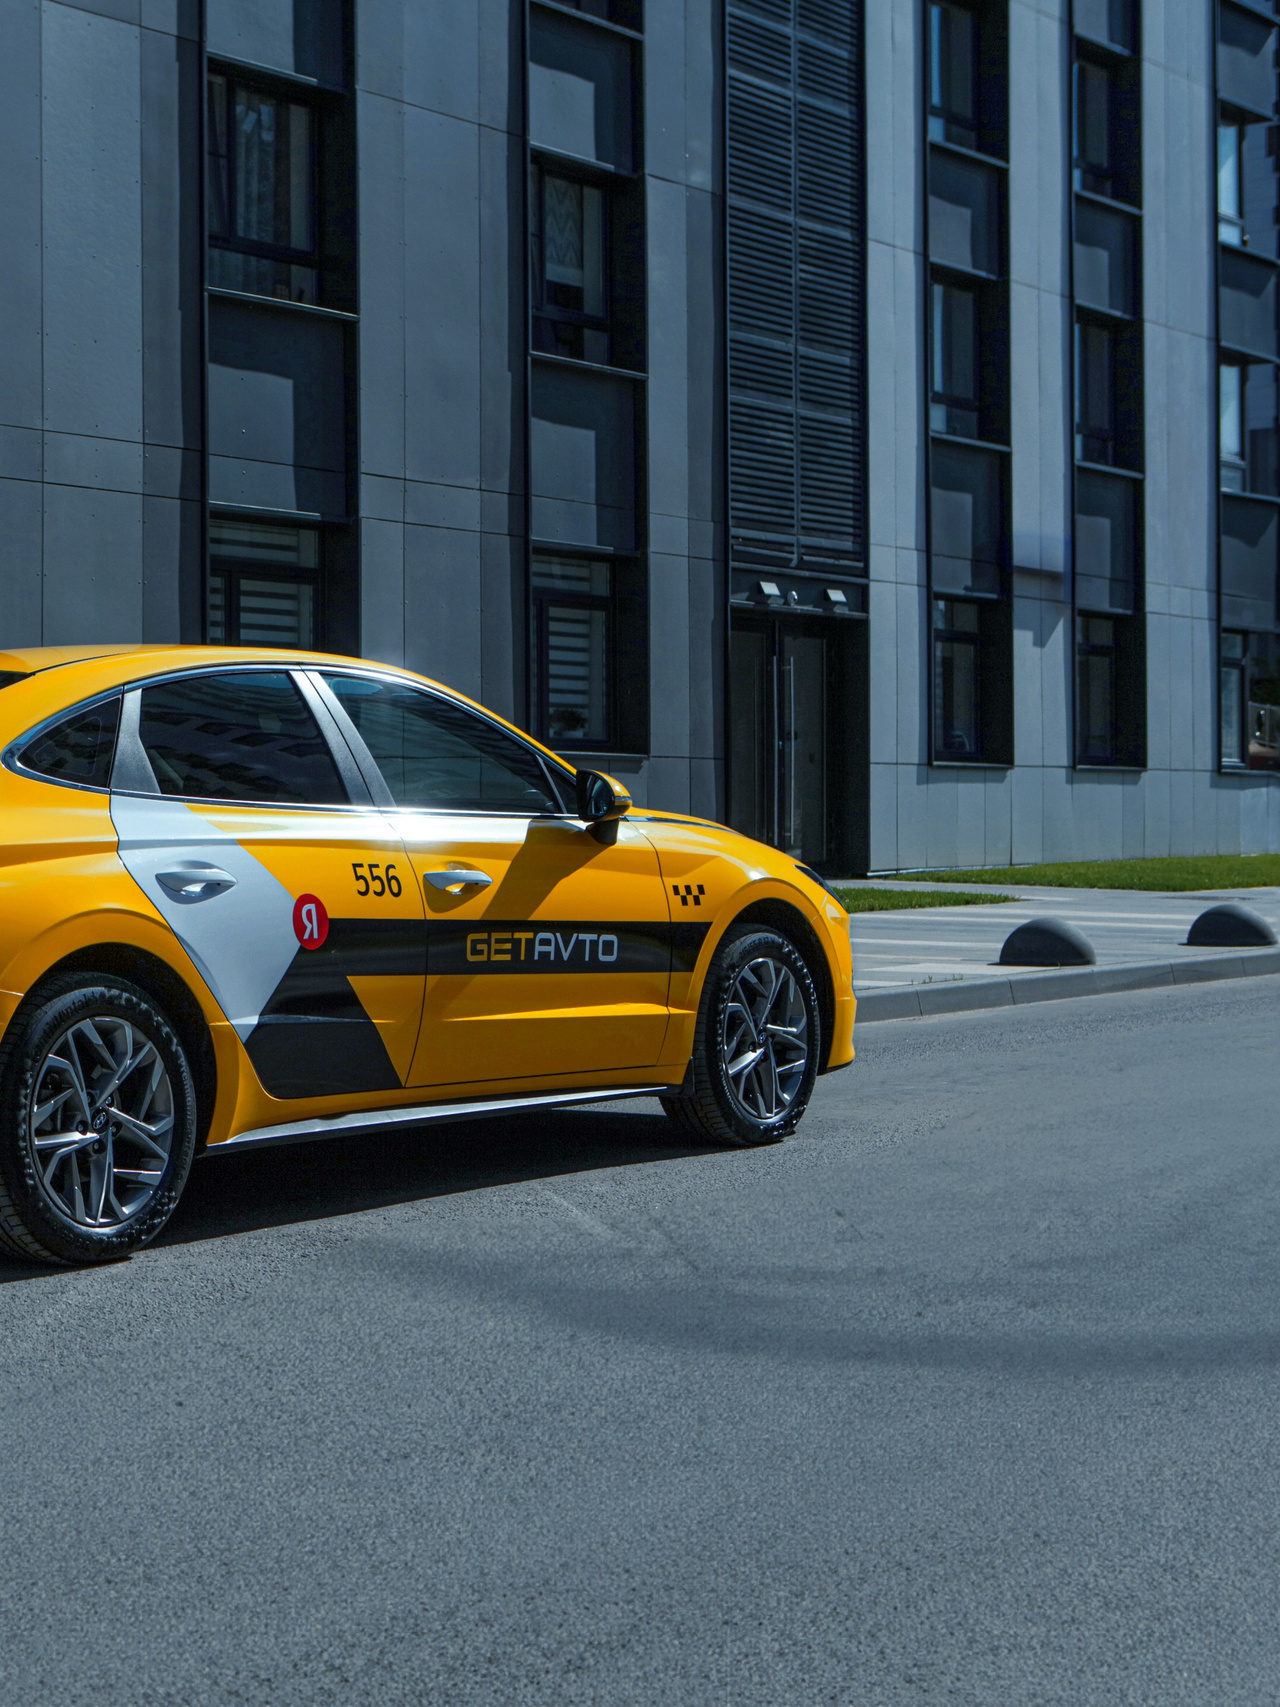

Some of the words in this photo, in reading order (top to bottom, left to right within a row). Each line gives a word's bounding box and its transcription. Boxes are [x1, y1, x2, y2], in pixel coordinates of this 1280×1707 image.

[351, 862, 403, 898] 556
[301, 902, 319, 940] Я
[466, 932, 618, 962] GETAVTO
